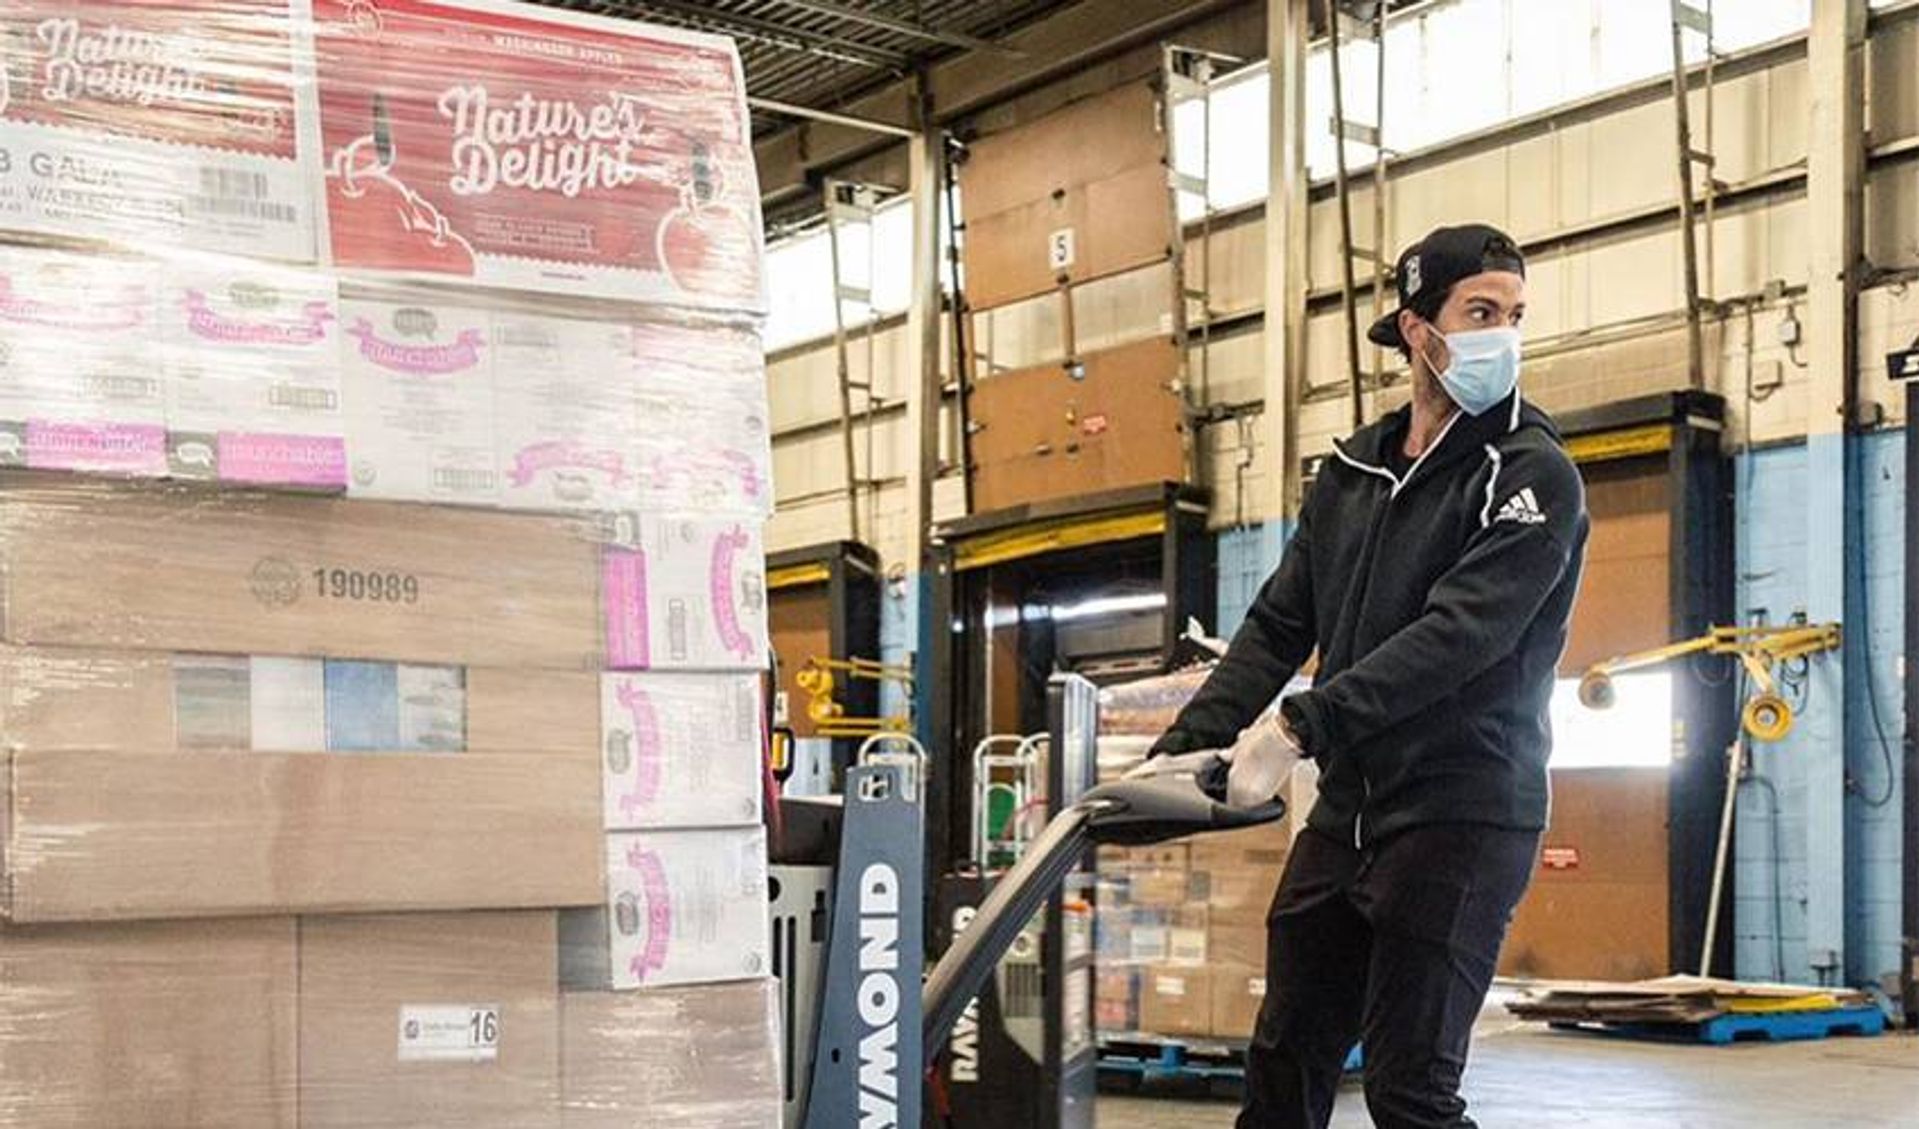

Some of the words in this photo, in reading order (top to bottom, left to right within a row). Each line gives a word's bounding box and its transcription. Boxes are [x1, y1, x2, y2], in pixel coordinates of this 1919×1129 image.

[437, 83, 646, 144] Nature's
[450, 136, 640, 197] Delight
[1056, 235, 1068, 262] 5
[312, 567, 420, 604] 190989
[470, 1010, 498, 1043] 16
